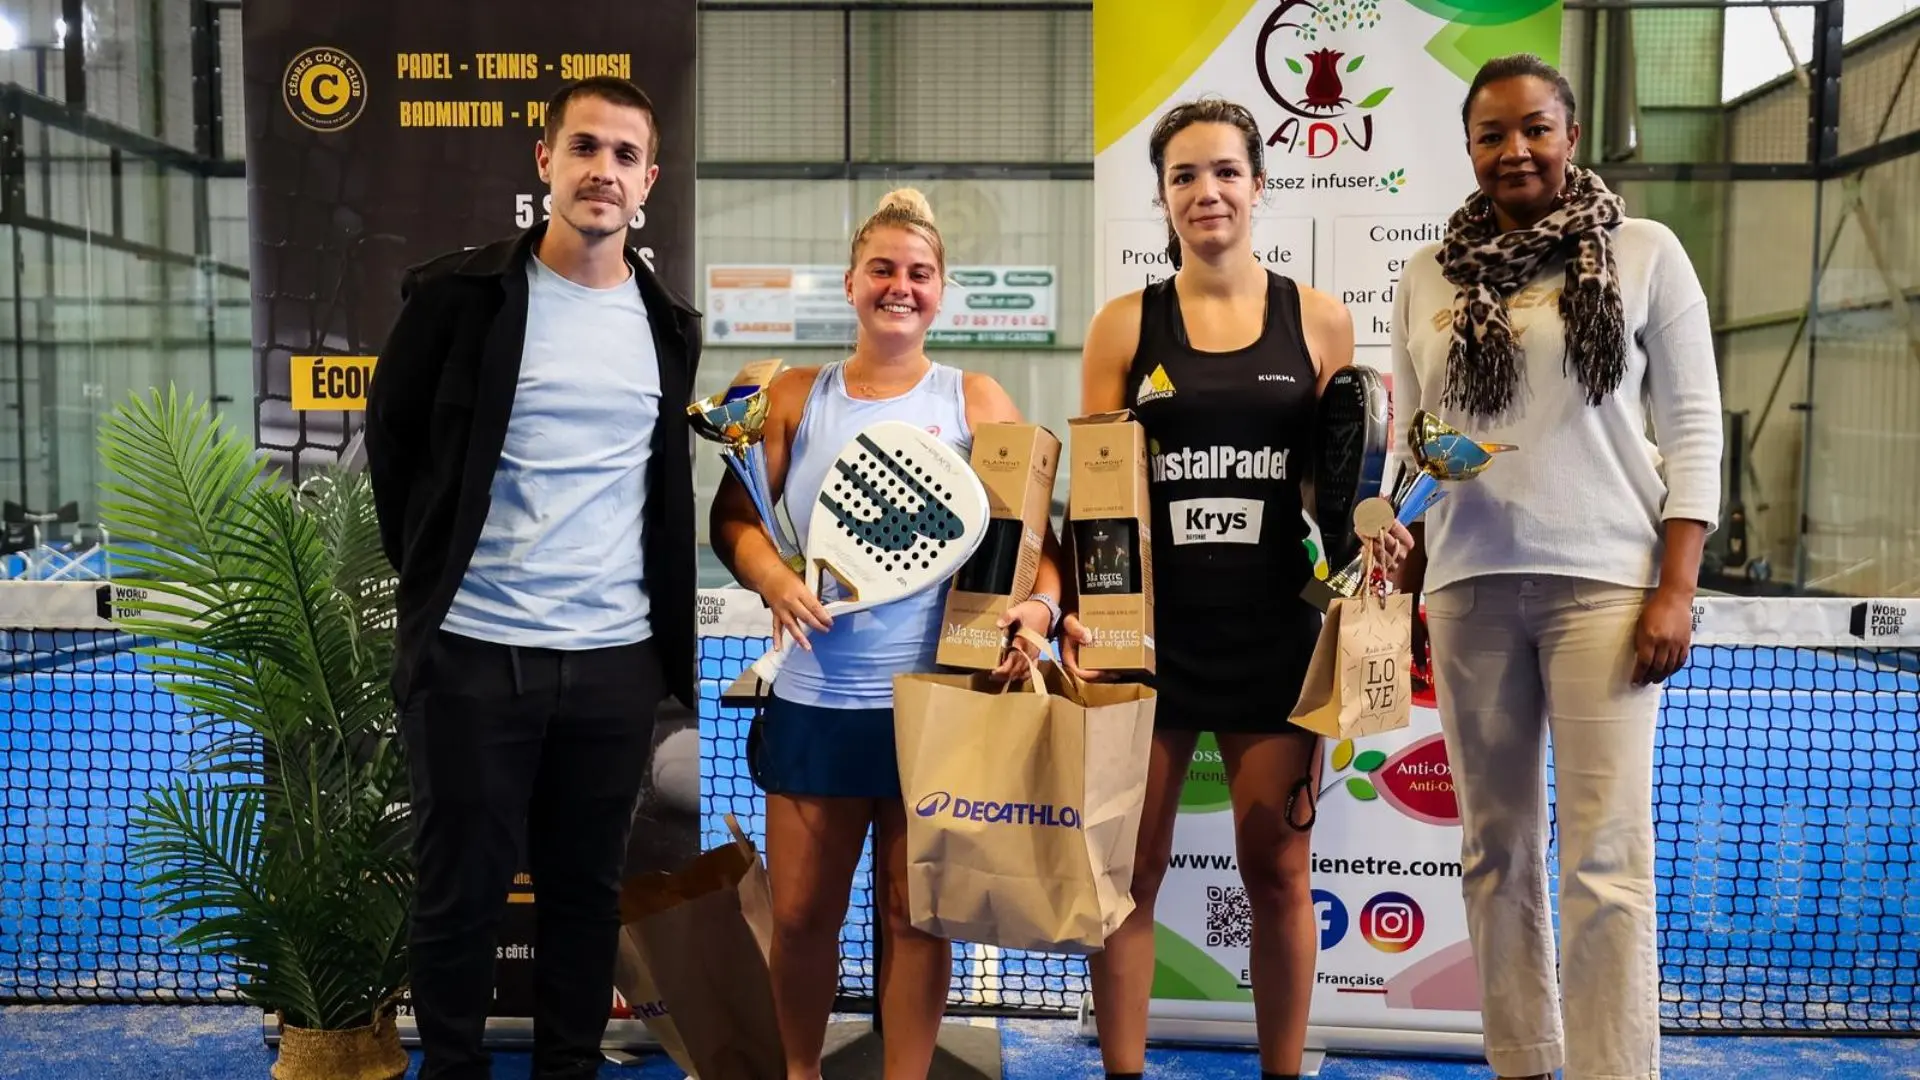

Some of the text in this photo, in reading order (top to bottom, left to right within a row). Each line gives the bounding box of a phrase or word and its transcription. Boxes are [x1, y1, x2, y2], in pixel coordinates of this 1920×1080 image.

[397, 53, 452, 79] PADEL
[476, 53, 538, 79] TENNIS
[560, 53, 631, 80] SQUASH
[311, 73, 339, 105] C
[346, 67, 361, 97] CLUB
[400, 101, 503, 127] BADMINTON
[1311, 173, 1379, 188] infuser.
[515, 194, 534, 229] 5
[1267, 245, 1292, 263] de
[1343, 290, 1376, 304] par
[1258, 374, 1296, 383] KUIKMA
[1186, 508, 1248, 535] Krys
[116, 588, 148, 599] WORLD
[1872, 604, 1907, 616] WORLD
[1872, 616, 1904, 625] PADEL
[1871, 625, 1900, 636] TOUR
[1367, 658, 1395, 684] LO
[1364, 685, 1394, 710] VE
[1317, 972, 1384, 988] Française
